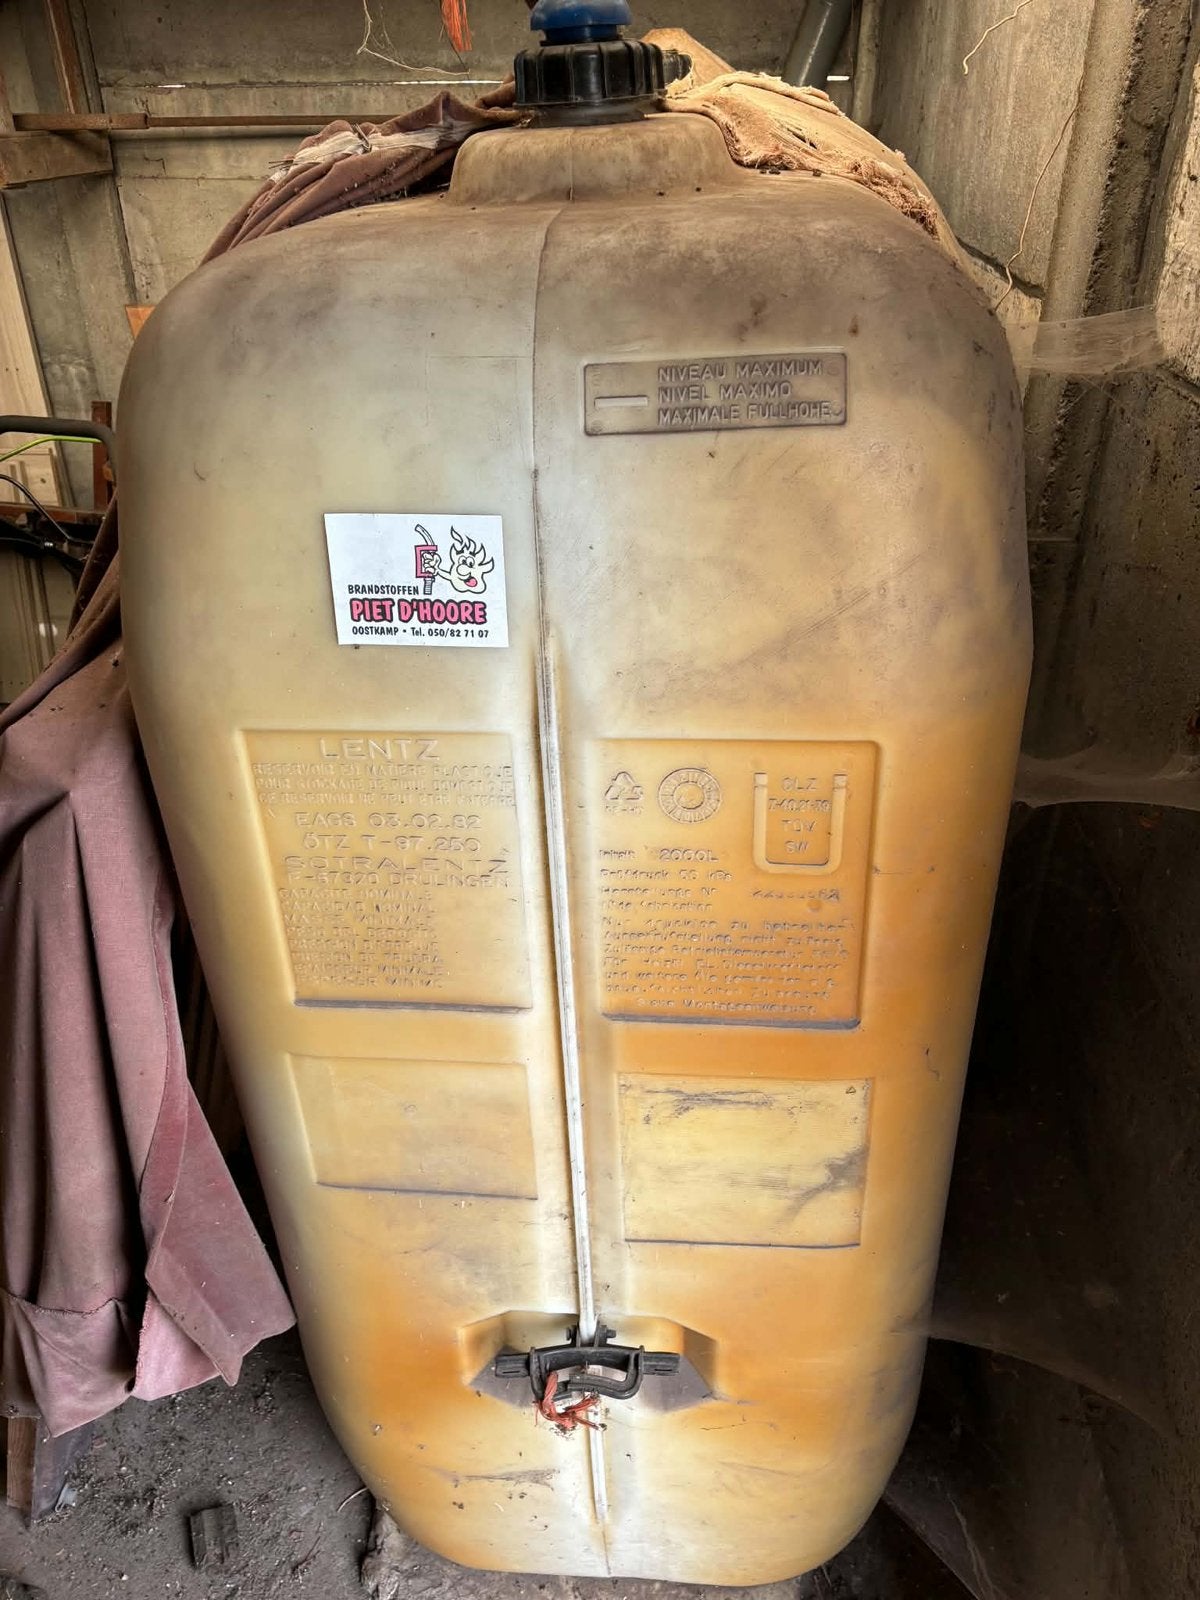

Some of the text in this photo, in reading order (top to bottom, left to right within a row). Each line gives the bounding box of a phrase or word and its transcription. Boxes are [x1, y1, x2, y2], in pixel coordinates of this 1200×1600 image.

[657, 359, 823, 383] NIVEAU MAXIMUM
[658, 380, 792, 404] NIVEL MAXIMO
[657, 404, 740, 427] MAXIMALE
[347, 584, 420, 596] BRANDSTOFFEN
[350, 597, 487, 625] PIET D'HOORE
[352, 625, 489, 638] OOSTKAMP Tel. 050/82 71 07
[319, 738, 440, 760] LENTZ
[295, 811, 357, 827] EAGS
[284, 855, 509, 873] SOTRALENTZ
